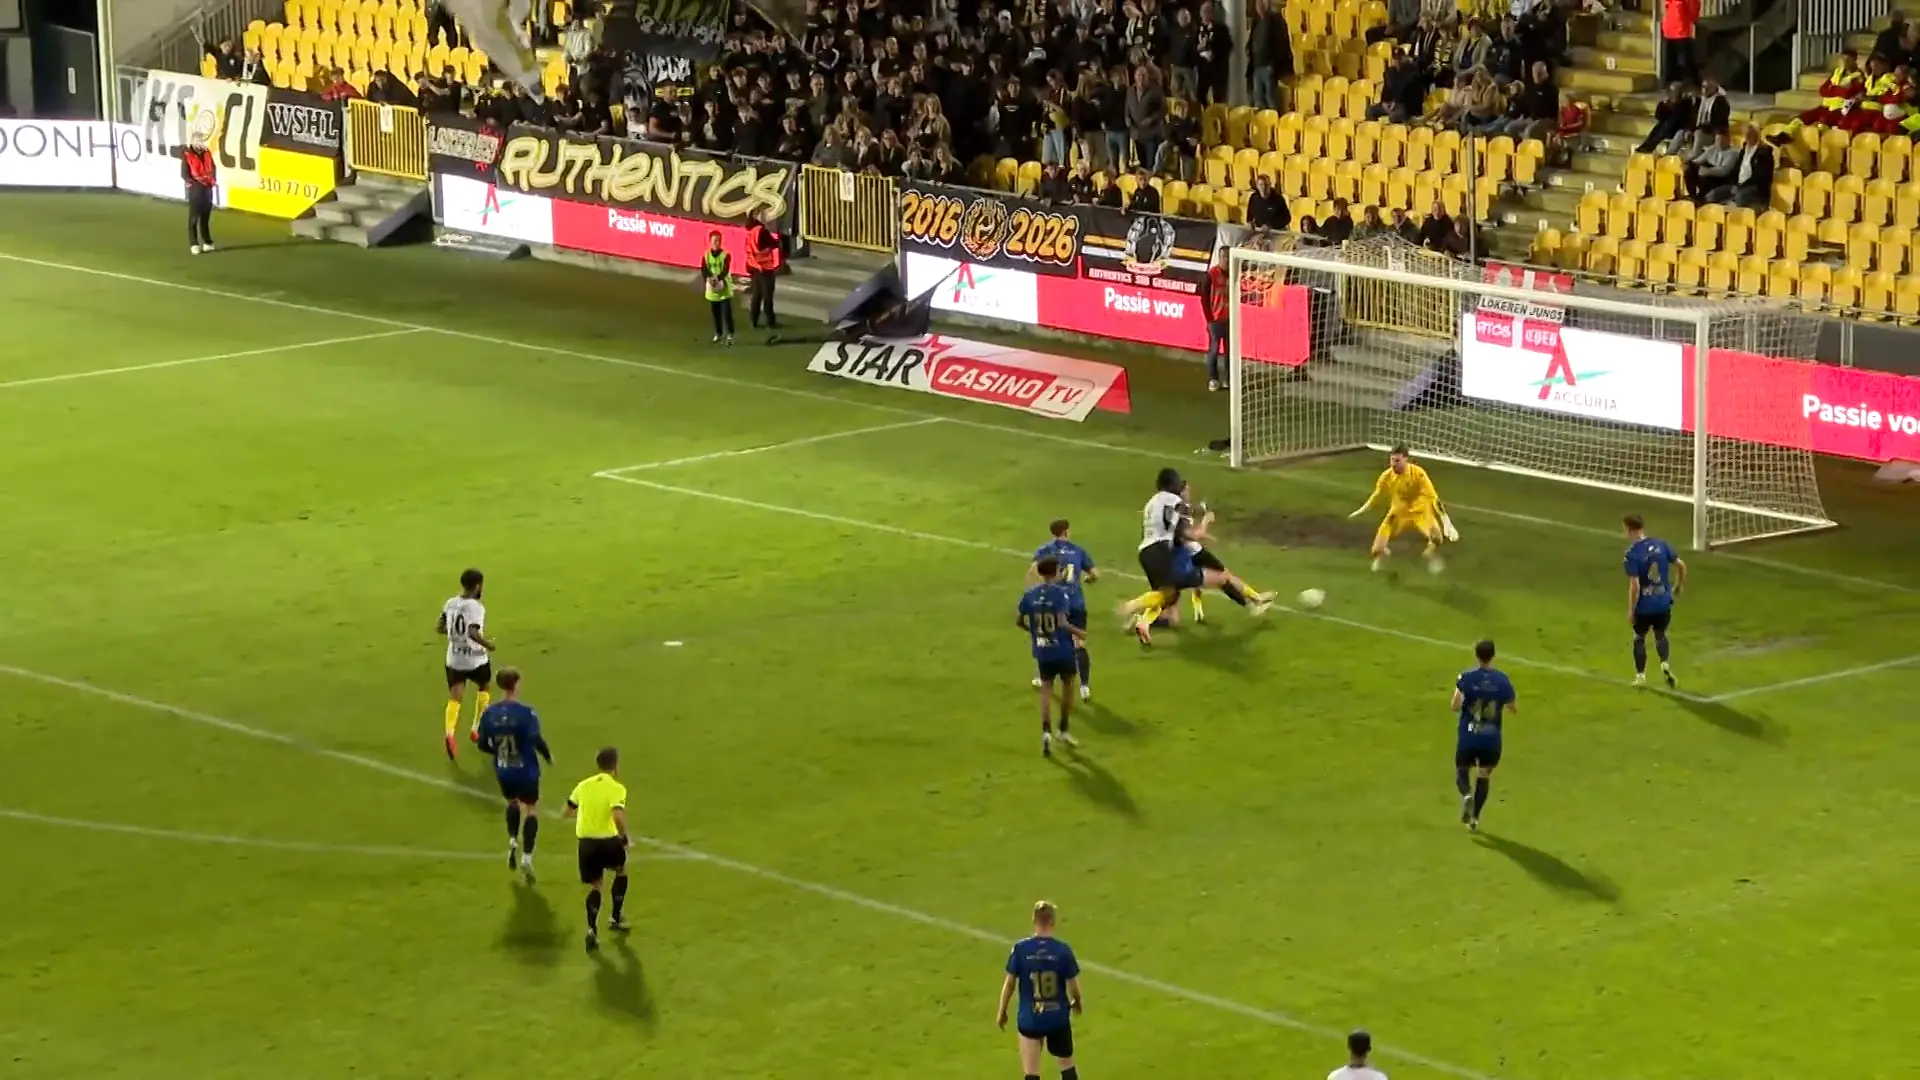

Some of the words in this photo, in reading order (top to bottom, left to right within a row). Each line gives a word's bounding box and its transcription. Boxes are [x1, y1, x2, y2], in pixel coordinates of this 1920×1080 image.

[267, 103, 339, 140] WSHL
[0, 123, 142, 162] ONHO
[303, 184, 319, 199] 07
[608, 208, 646, 235] Passie
[648, 220, 675, 238] voor
[902, 191, 963, 245] 2016
[1005, 208, 1079, 264] 2026
[1104, 287, 1151, 314] Passie
[1153, 299, 1185, 318] voor
[1481, 297, 1528, 315] LOKEREN
[1529, 307, 1564, 321] JUNGS
[824, 340, 925, 385] STAR
[938, 364, 1041, 400] CASINO
[1046, 384, 1087, 406] TV
[1553, 391, 1617, 411] ACCURIA
[1802, 393, 1883, 431] Passie
[1887, 413, 1920, 435] vo
[1033, 612, 1056, 634] 10
[1030, 970, 1058, 1000] 18
